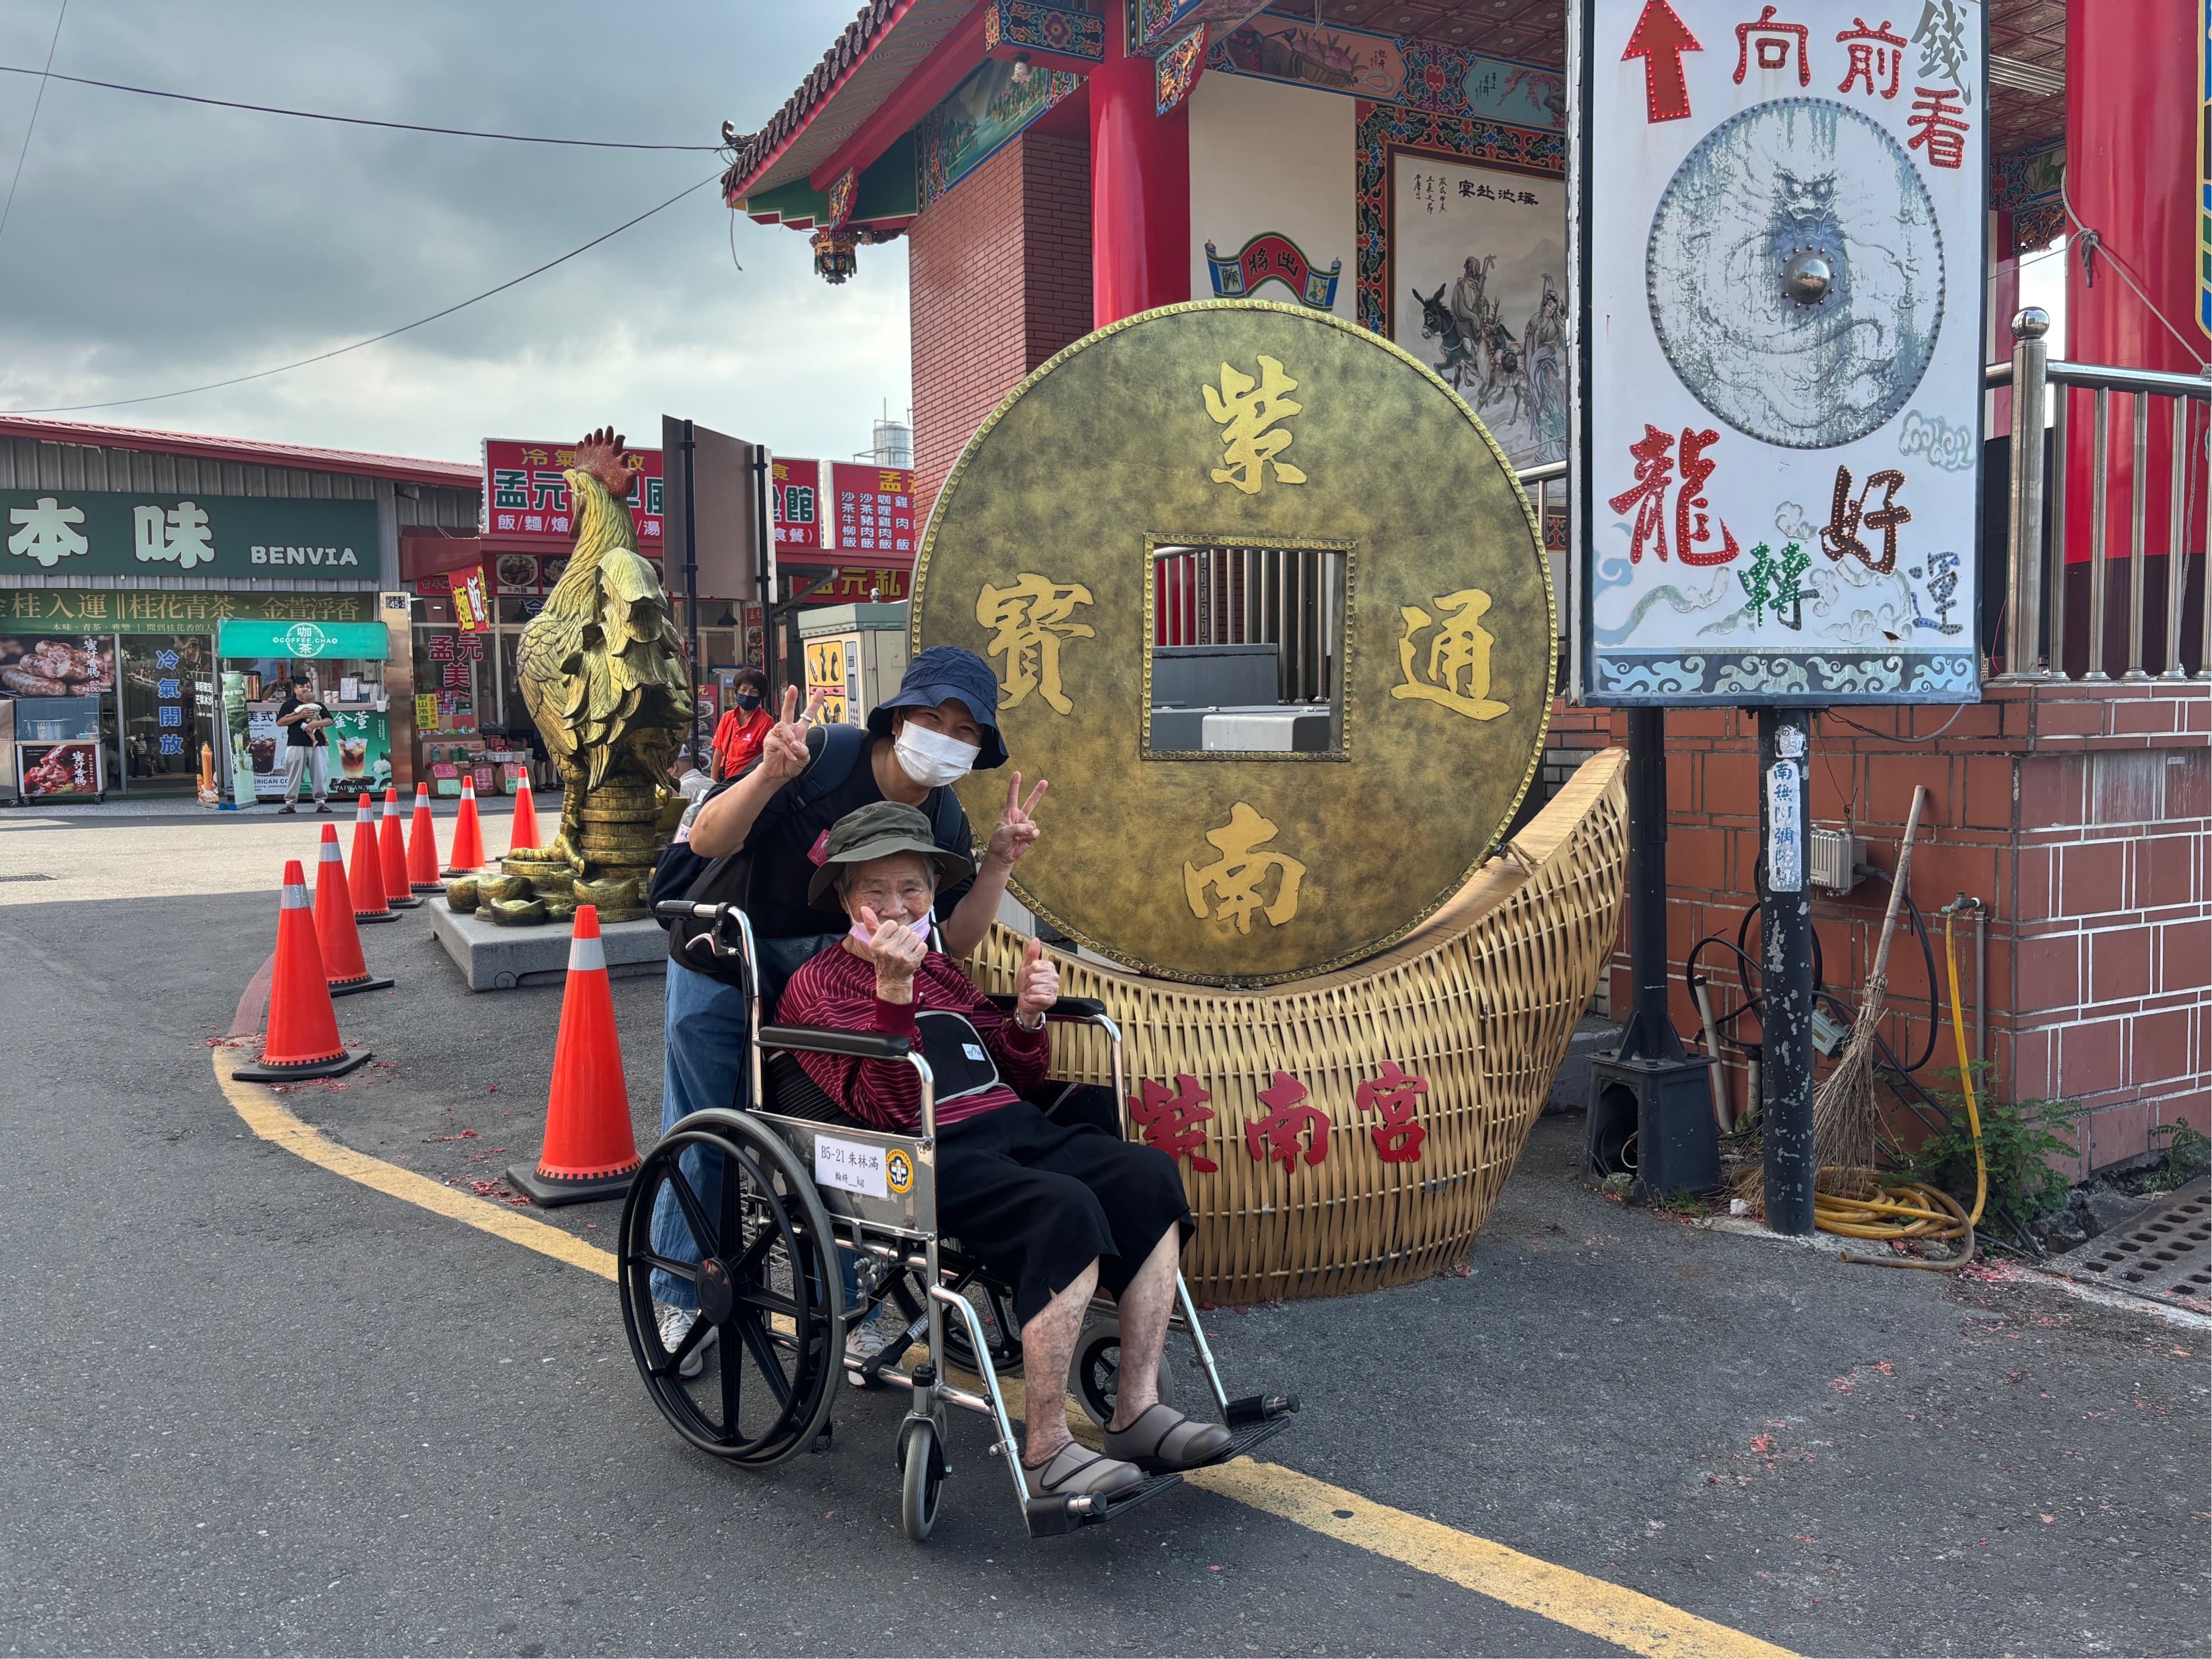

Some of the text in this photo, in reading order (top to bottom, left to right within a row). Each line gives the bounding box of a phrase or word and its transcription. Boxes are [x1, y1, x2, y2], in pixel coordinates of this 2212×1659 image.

[8, 497, 215, 568] 本味
[841, 491, 856, 548] 沙茶牛柳飯
[859, 492, 875, 549] 沙茶豬肉飯
[878, 494, 892, 550] 咖哩雞肉飯
[251, 545, 358, 566] BENVIA
[0, 592, 108, 619] 桂入運
[429, 635, 483, 661] 孟元
[156, 649, 184, 756] 冷氣開放
[821, 1145, 845, 1163] B5-21
